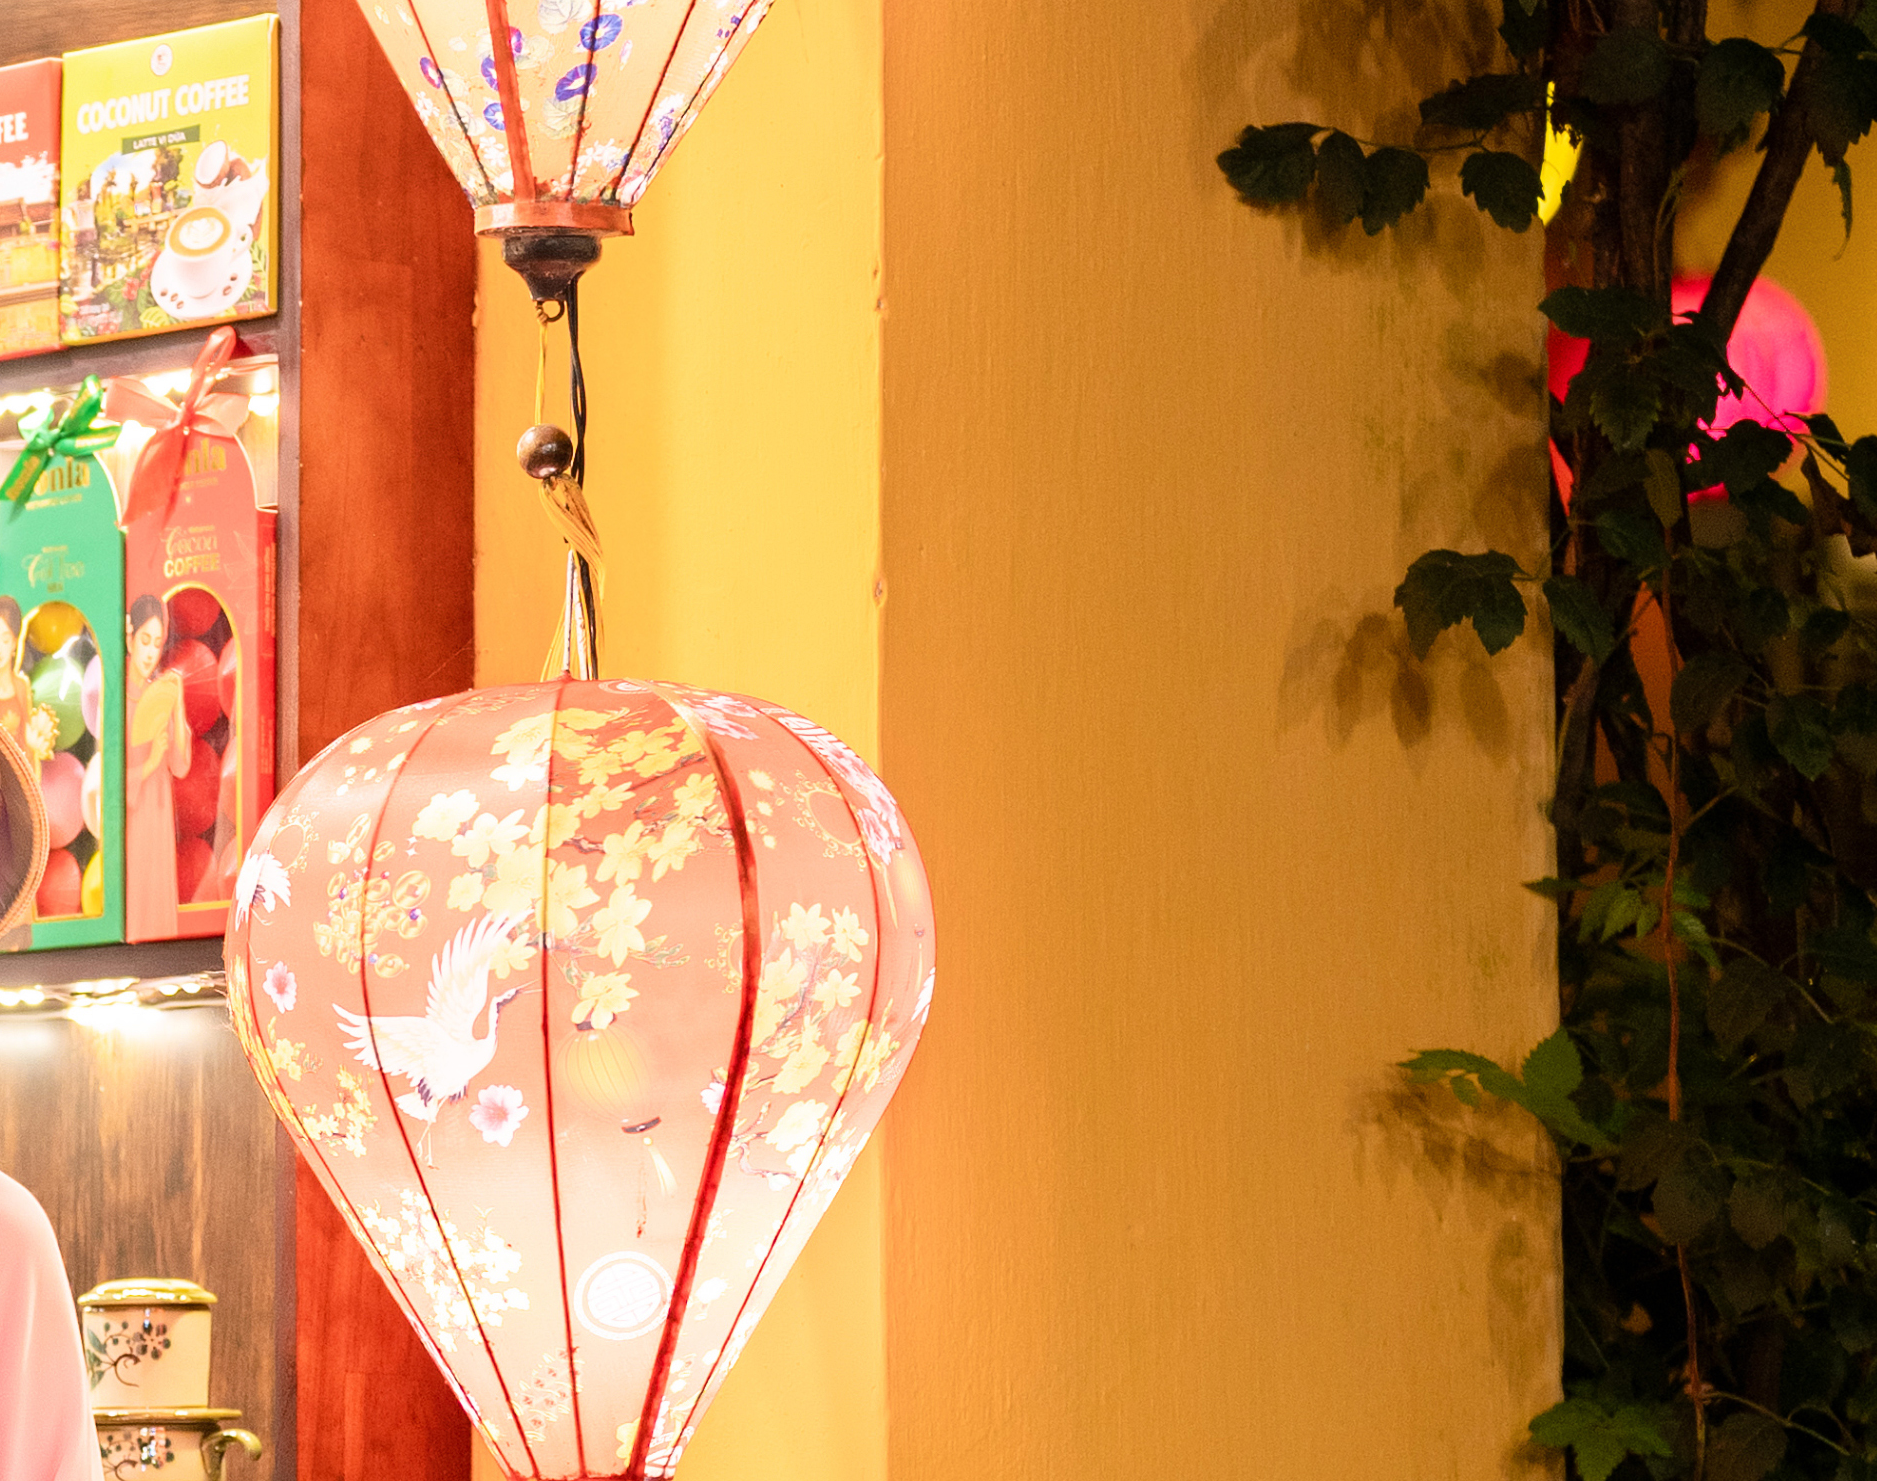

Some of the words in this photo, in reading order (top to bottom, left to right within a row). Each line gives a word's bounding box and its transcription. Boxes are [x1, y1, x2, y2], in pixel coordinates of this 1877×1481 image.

[77, 88, 171, 134] COCONUT
[175, 74, 250, 116] COFFEE
[33, 455, 91, 497] onla
[163, 553, 220, 580] COFFEE
